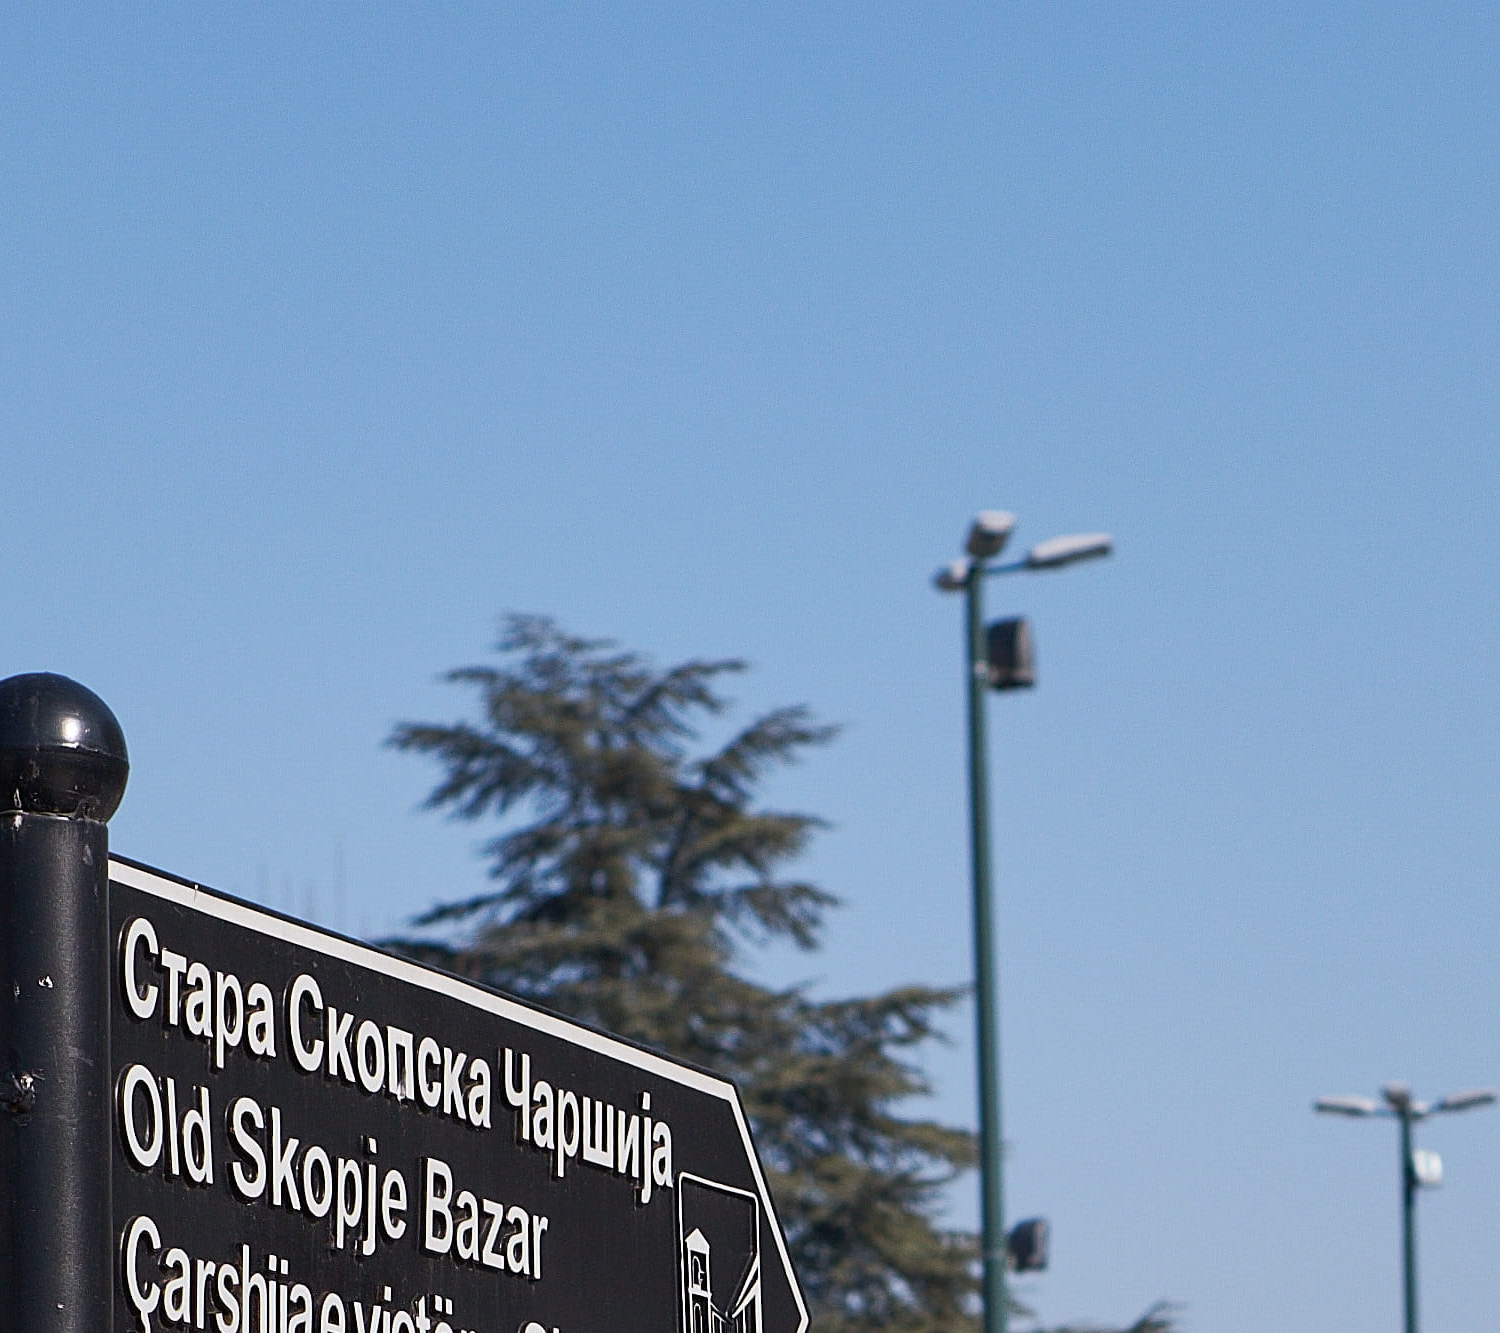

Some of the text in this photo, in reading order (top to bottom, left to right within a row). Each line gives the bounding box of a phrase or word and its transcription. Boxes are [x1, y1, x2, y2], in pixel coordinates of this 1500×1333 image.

[122, 1064, 548, 1280] Old Skopje Bazar
[124, 917, 673, 1205] Стара Скопска Чаршија
